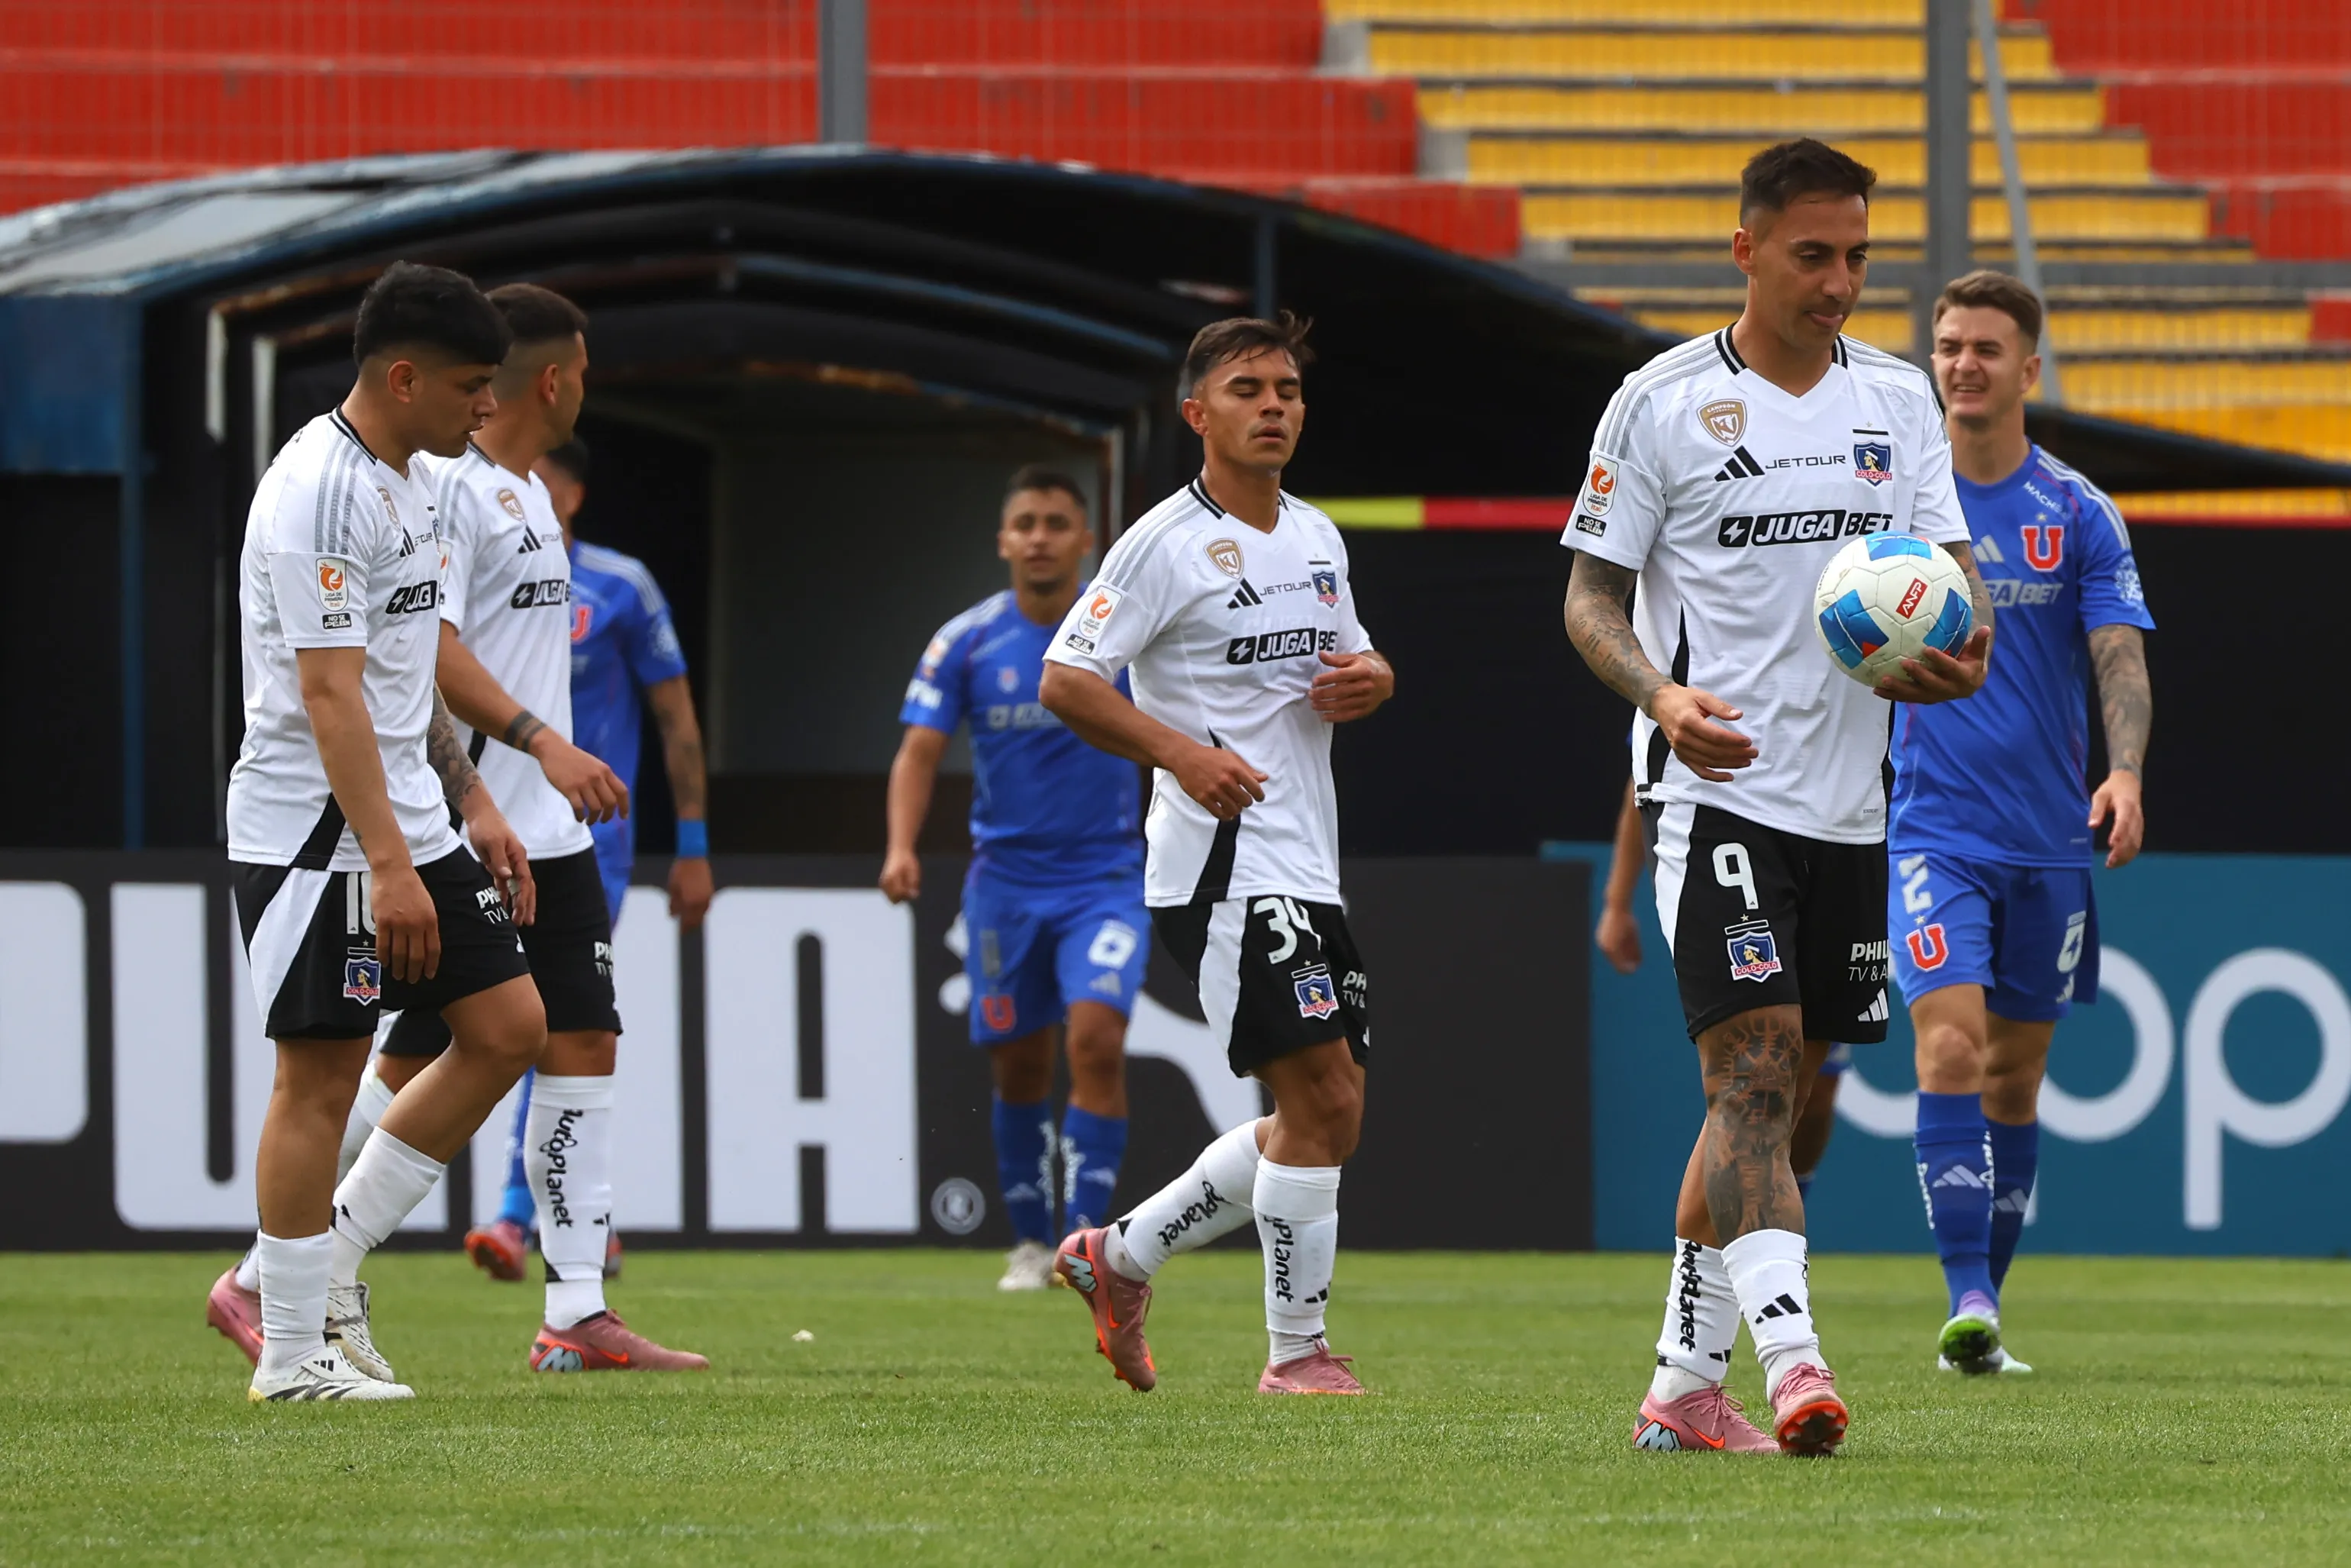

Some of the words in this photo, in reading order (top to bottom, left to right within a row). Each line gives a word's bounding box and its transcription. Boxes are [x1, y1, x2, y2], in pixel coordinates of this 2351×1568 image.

[1765, 455, 1846, 469] JETOUR
[1856, 470, 1891, 480] COLO-COLO
[1588, 498, 1608, 508] PRIMERA
[1578, 523, 1603, 535] PELEEN
[1756, 513, 1836, 543] JUGA
[1844, 513, 1893, 536] BET
[2020, 524, 2064, 572] U
[1259, 580, 1312, 596] JETOUR
[1901, 581, 1923, 616] ANFP
[1259, 631, 1311, 659] JUGA
[1318, 631, 1337, 651] BE
[1712, 842, 1759, 910] 9
[1898, 853, 1933, 915] 2
[484, 908, 501, 924] TV
[1253, 896, 1321, 965] 34
[1905, 923, 1949, 972] U
[1735, 962, 1778, 975] COLO-COLO
[1848, 966, 1868, 982] TV
[1870, 965, 1879, 982] &
[1272, 1216, 1294, 1303] planet
